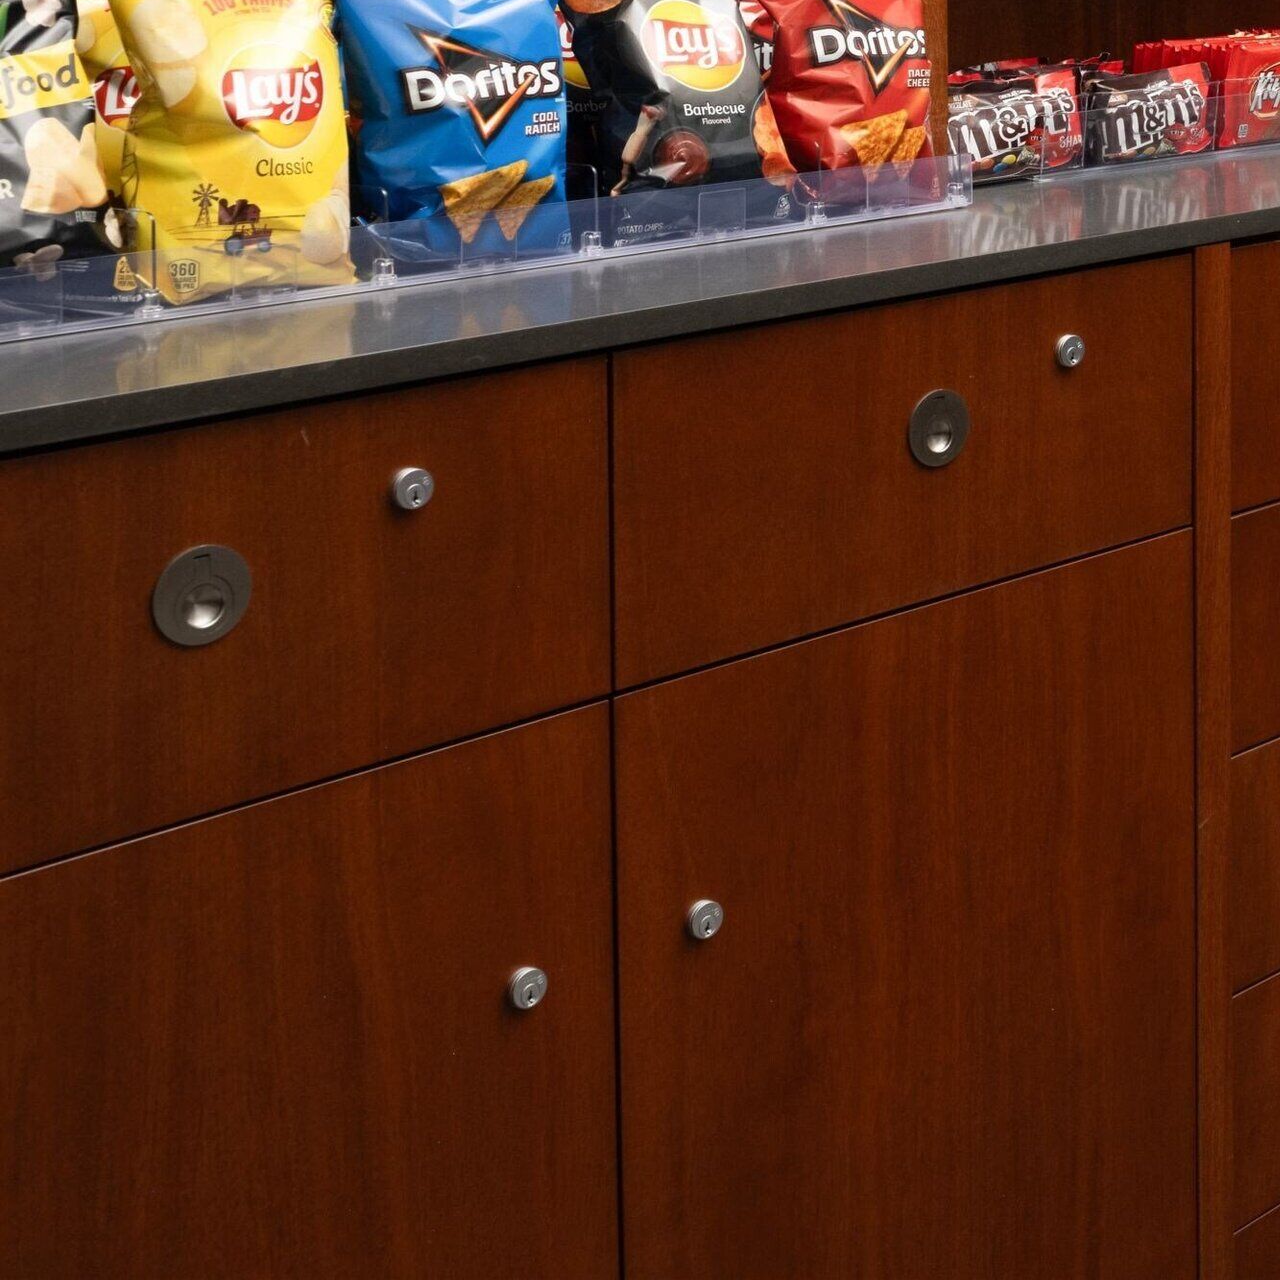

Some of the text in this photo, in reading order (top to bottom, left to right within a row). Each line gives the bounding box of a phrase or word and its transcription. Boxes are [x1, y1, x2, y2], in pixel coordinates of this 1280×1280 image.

[651, 19, 738, 69] Lay's
[0, 52, 80, 111] food
[404, 60, 562, 112] Doritos
[231, 65, 320, 126] Lay's
[532, 111, 560, 124] COOL
[683, 101, 747, 118] Barbecue
[524, 122, 561, 137] RANCH
[701, 116, 732, 126] Flavored
[254, 158, 314, 178] Classic
[616, 222, 664, 235] POTATO CHIPS
[169, 262, 197, 277] 360
